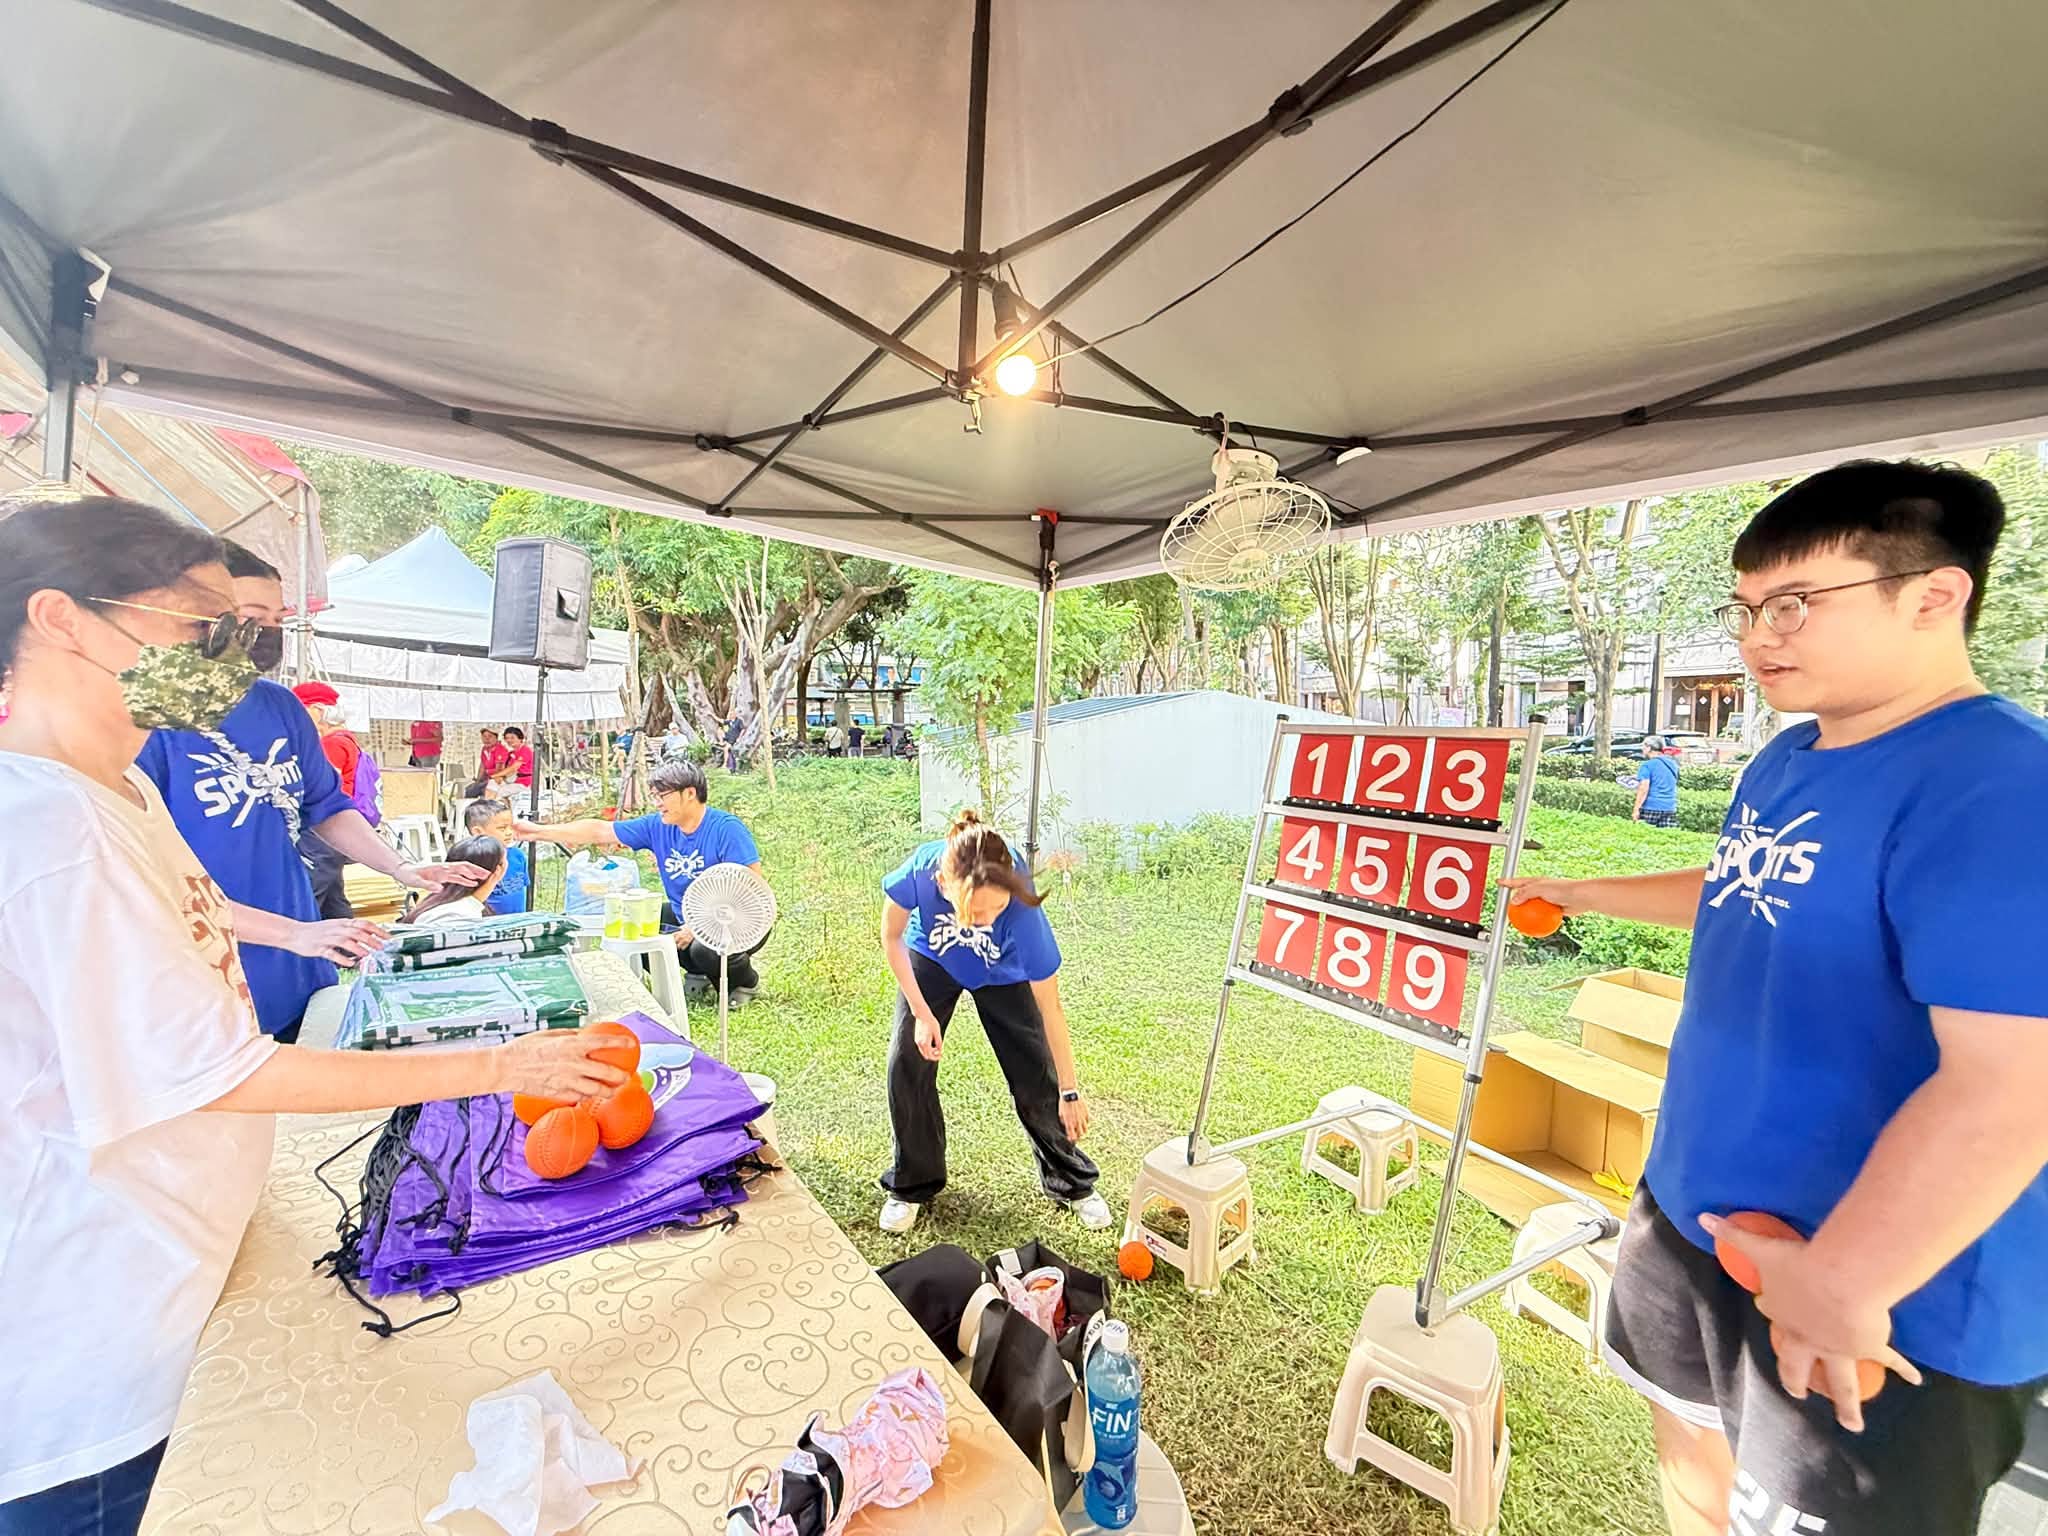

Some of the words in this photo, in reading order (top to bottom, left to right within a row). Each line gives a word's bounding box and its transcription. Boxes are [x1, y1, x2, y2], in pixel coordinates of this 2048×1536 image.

[1307, 742, 1329, 795] 1
[1365, 743, 1411, 802] 2
[1441, 749, 1487, 811] 3
[1286, 825, 1324, 880] 4
[1350, 836, 1391, 895] 5
[1423, 846, 1473, 910] 6
[1274, 908, 1305, 964] 7
[1326, 926, 1372, 988] 8
[1402, 944, 1446, 1011] 9
[1091, 1406, 1132, 1433] FIN
